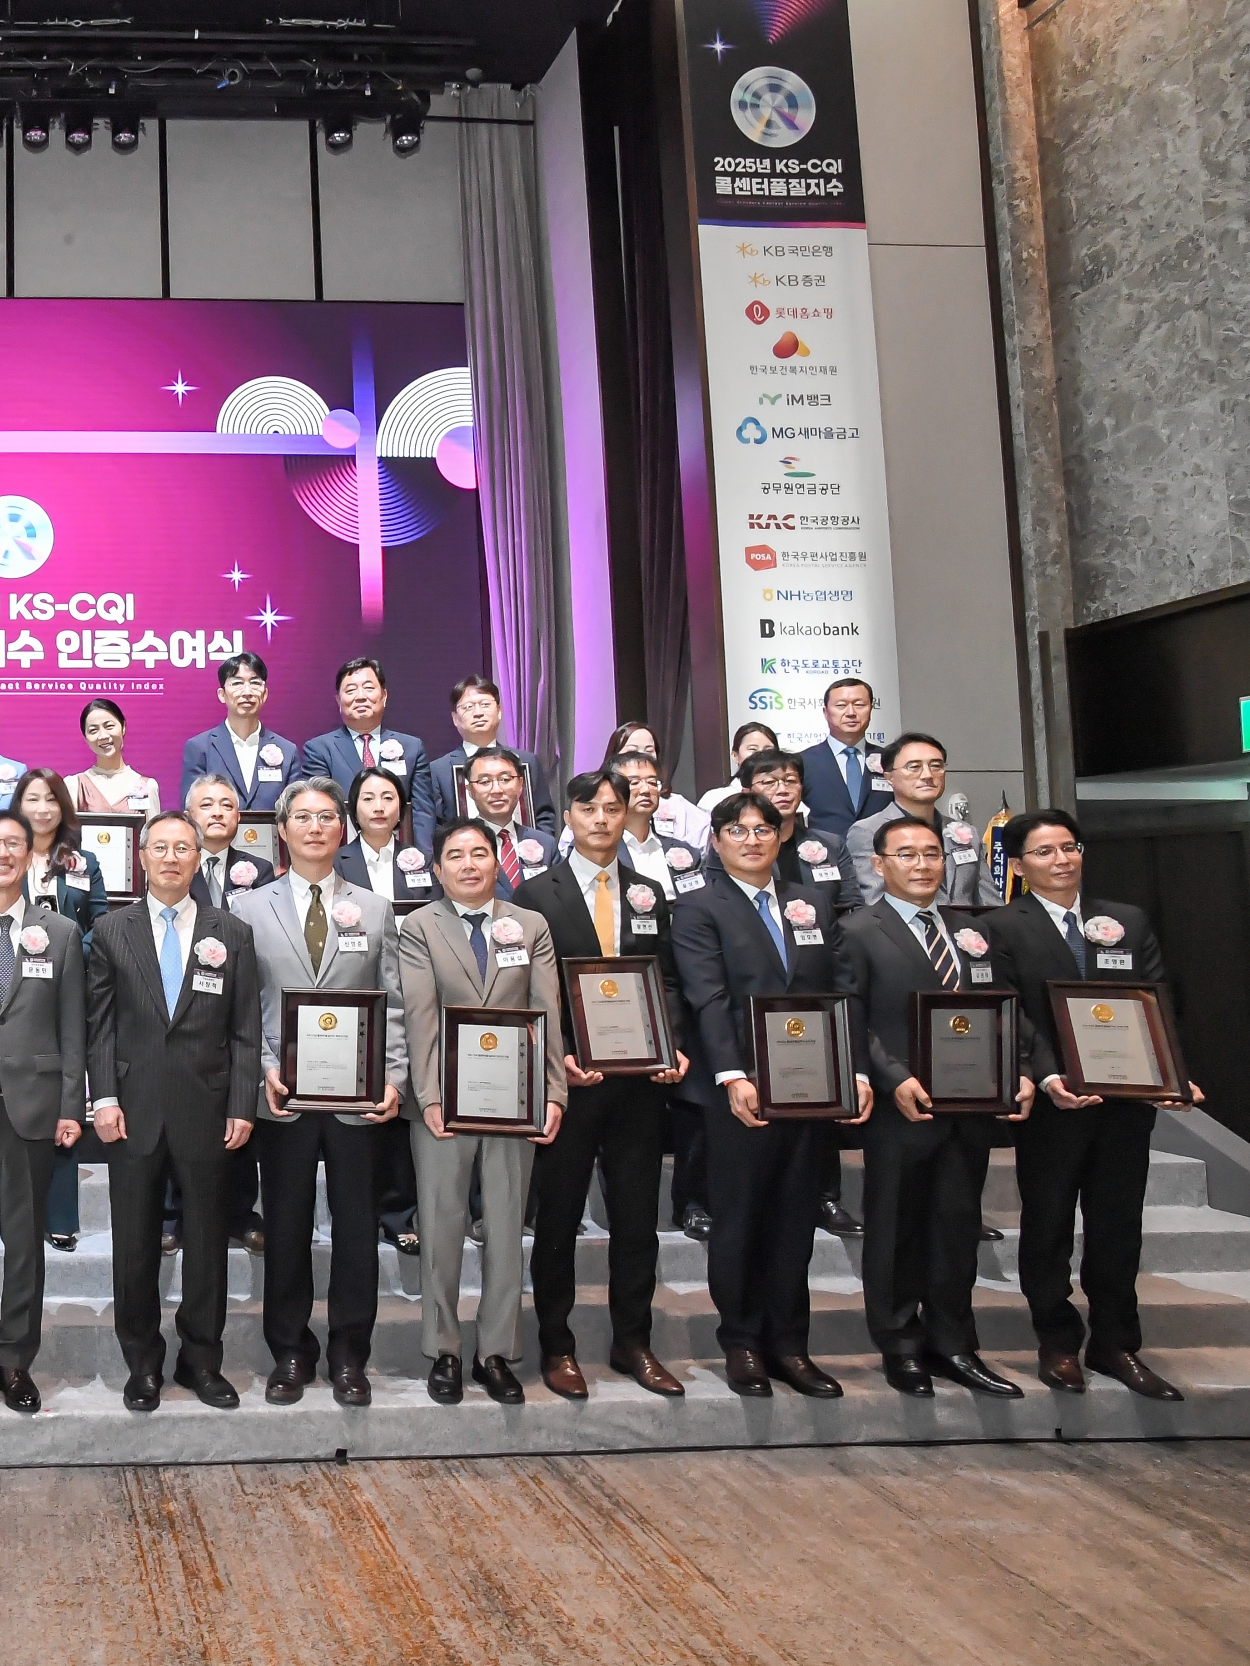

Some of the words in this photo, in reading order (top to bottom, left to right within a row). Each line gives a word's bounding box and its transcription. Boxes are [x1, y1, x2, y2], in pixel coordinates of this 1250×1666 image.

[713, 157, 771, 173] 2025년
[775, 159, 842, 175] KS-CQI
[715, 176, 844, 196] 콜센터품질지수
[775, 307, 833, 320] 롯데홈쇼핑
[761, 483, 841, 496] 공무원연금공단
[748, 514, 796, 530] KAC
[799, 516, 860, 525] 한국공항공사
[750, 553, 772, 561] POSA
[781, 551, 867, 562] 한국우편사업진흥원
[9, 592, 135, 624] KS-CQI
[779, 623, 860, 636] kakaobank
[55, 629, 244, 669] 인증수여식
[780, 658, 863, 674] 한국도로교통공단
[25, 682, 74, 691] Service
[79, 682, 125, 692] Quality
[131, 682, 164, 691] Index
[993, 841, 1004, 889] 주식회사
